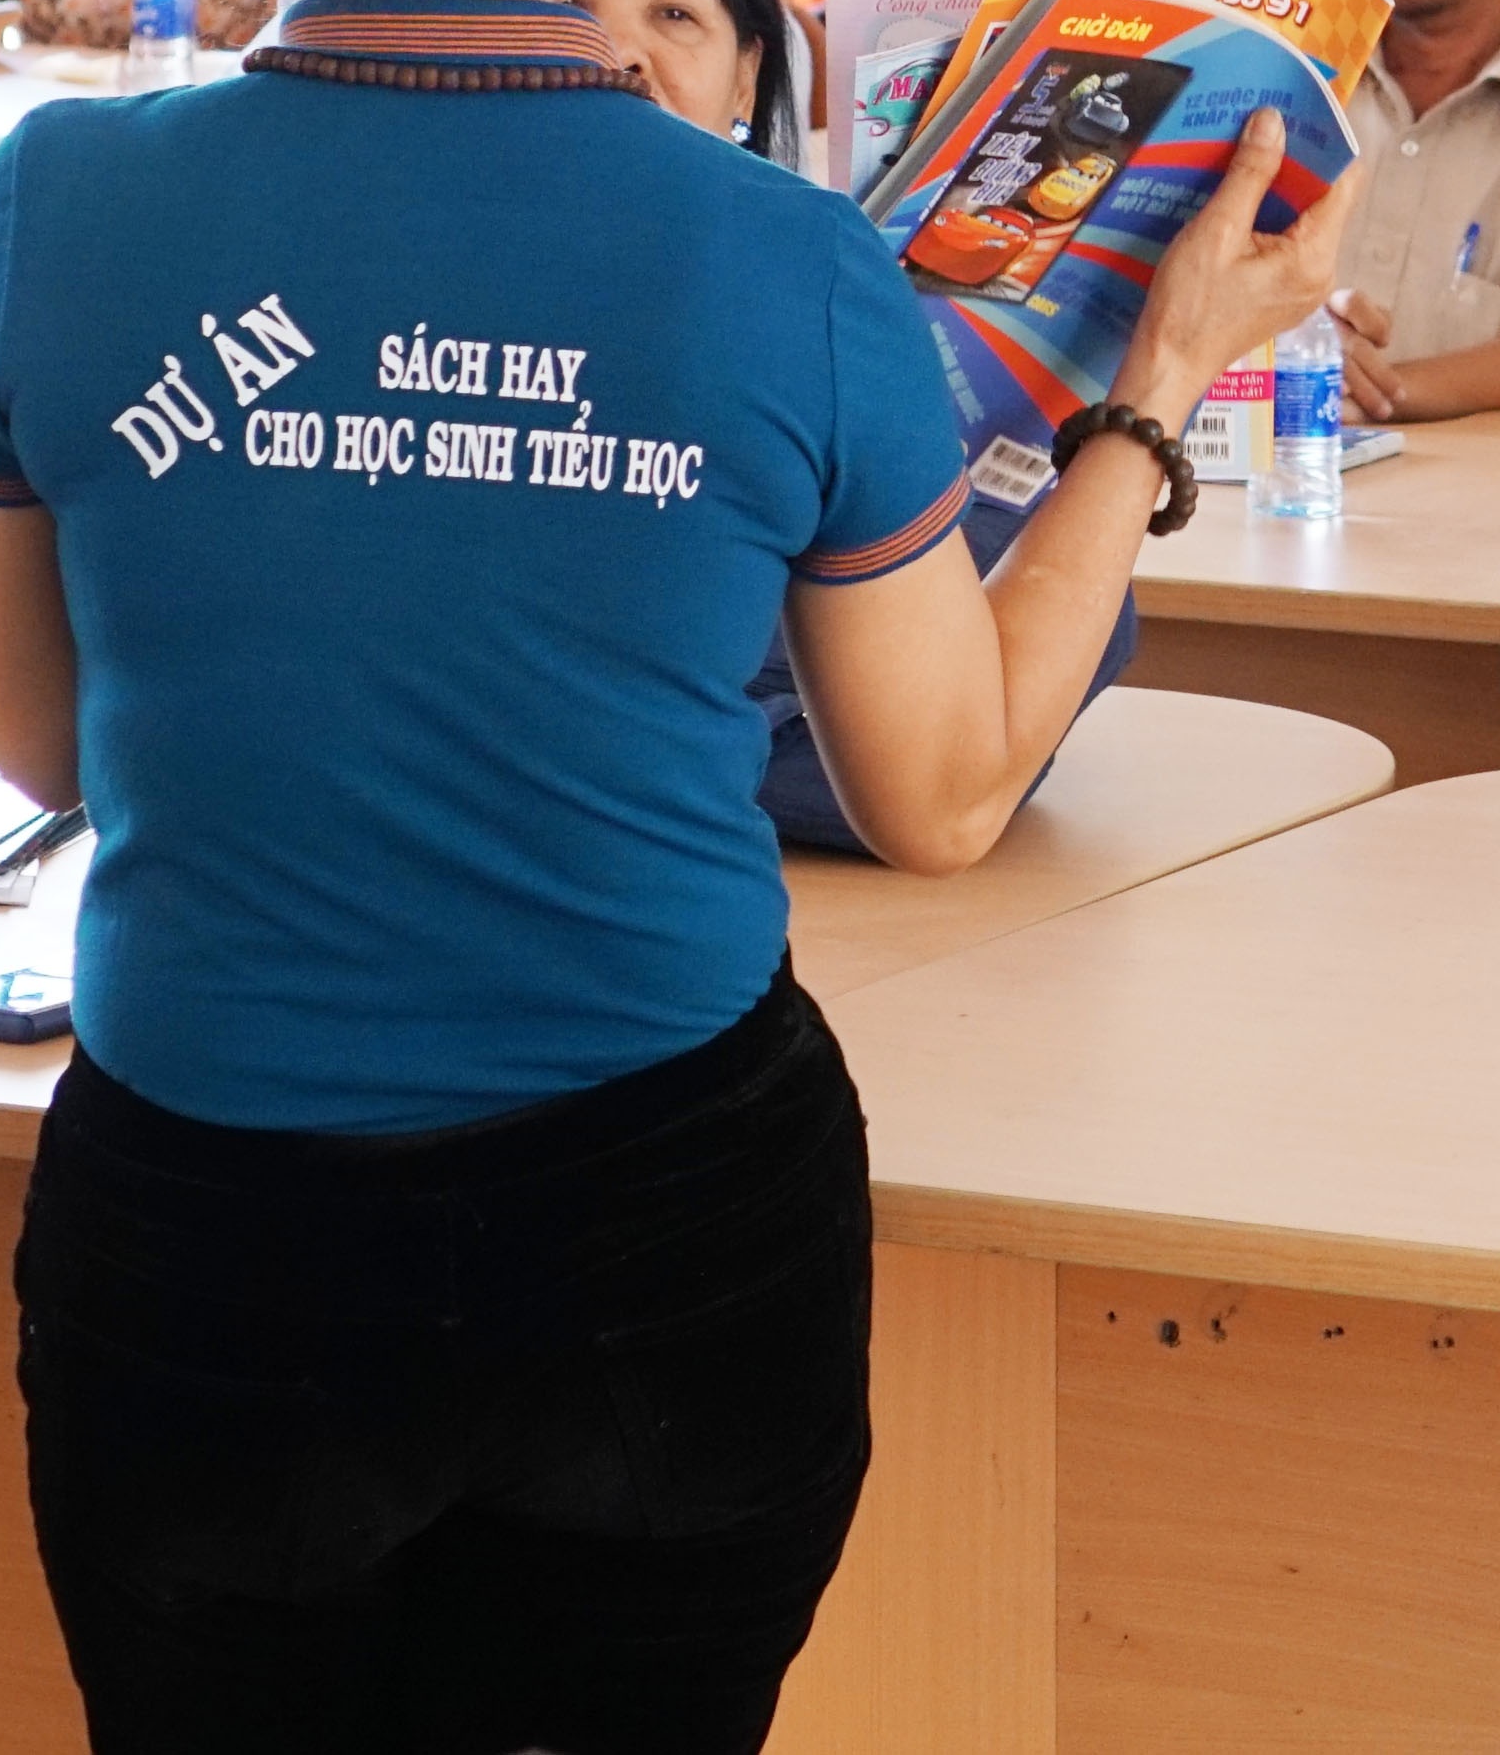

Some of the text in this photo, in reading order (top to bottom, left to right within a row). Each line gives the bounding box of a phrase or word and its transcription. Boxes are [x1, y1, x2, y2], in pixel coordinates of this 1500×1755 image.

[888, 74, 942, 101] MA
[112, 293, 316, 479] DỰ ÁN
[379, 322, 490, 395] SÁCH
[245, 400, 703, 509] CHO HỌC SINH TIỂU HỌC
